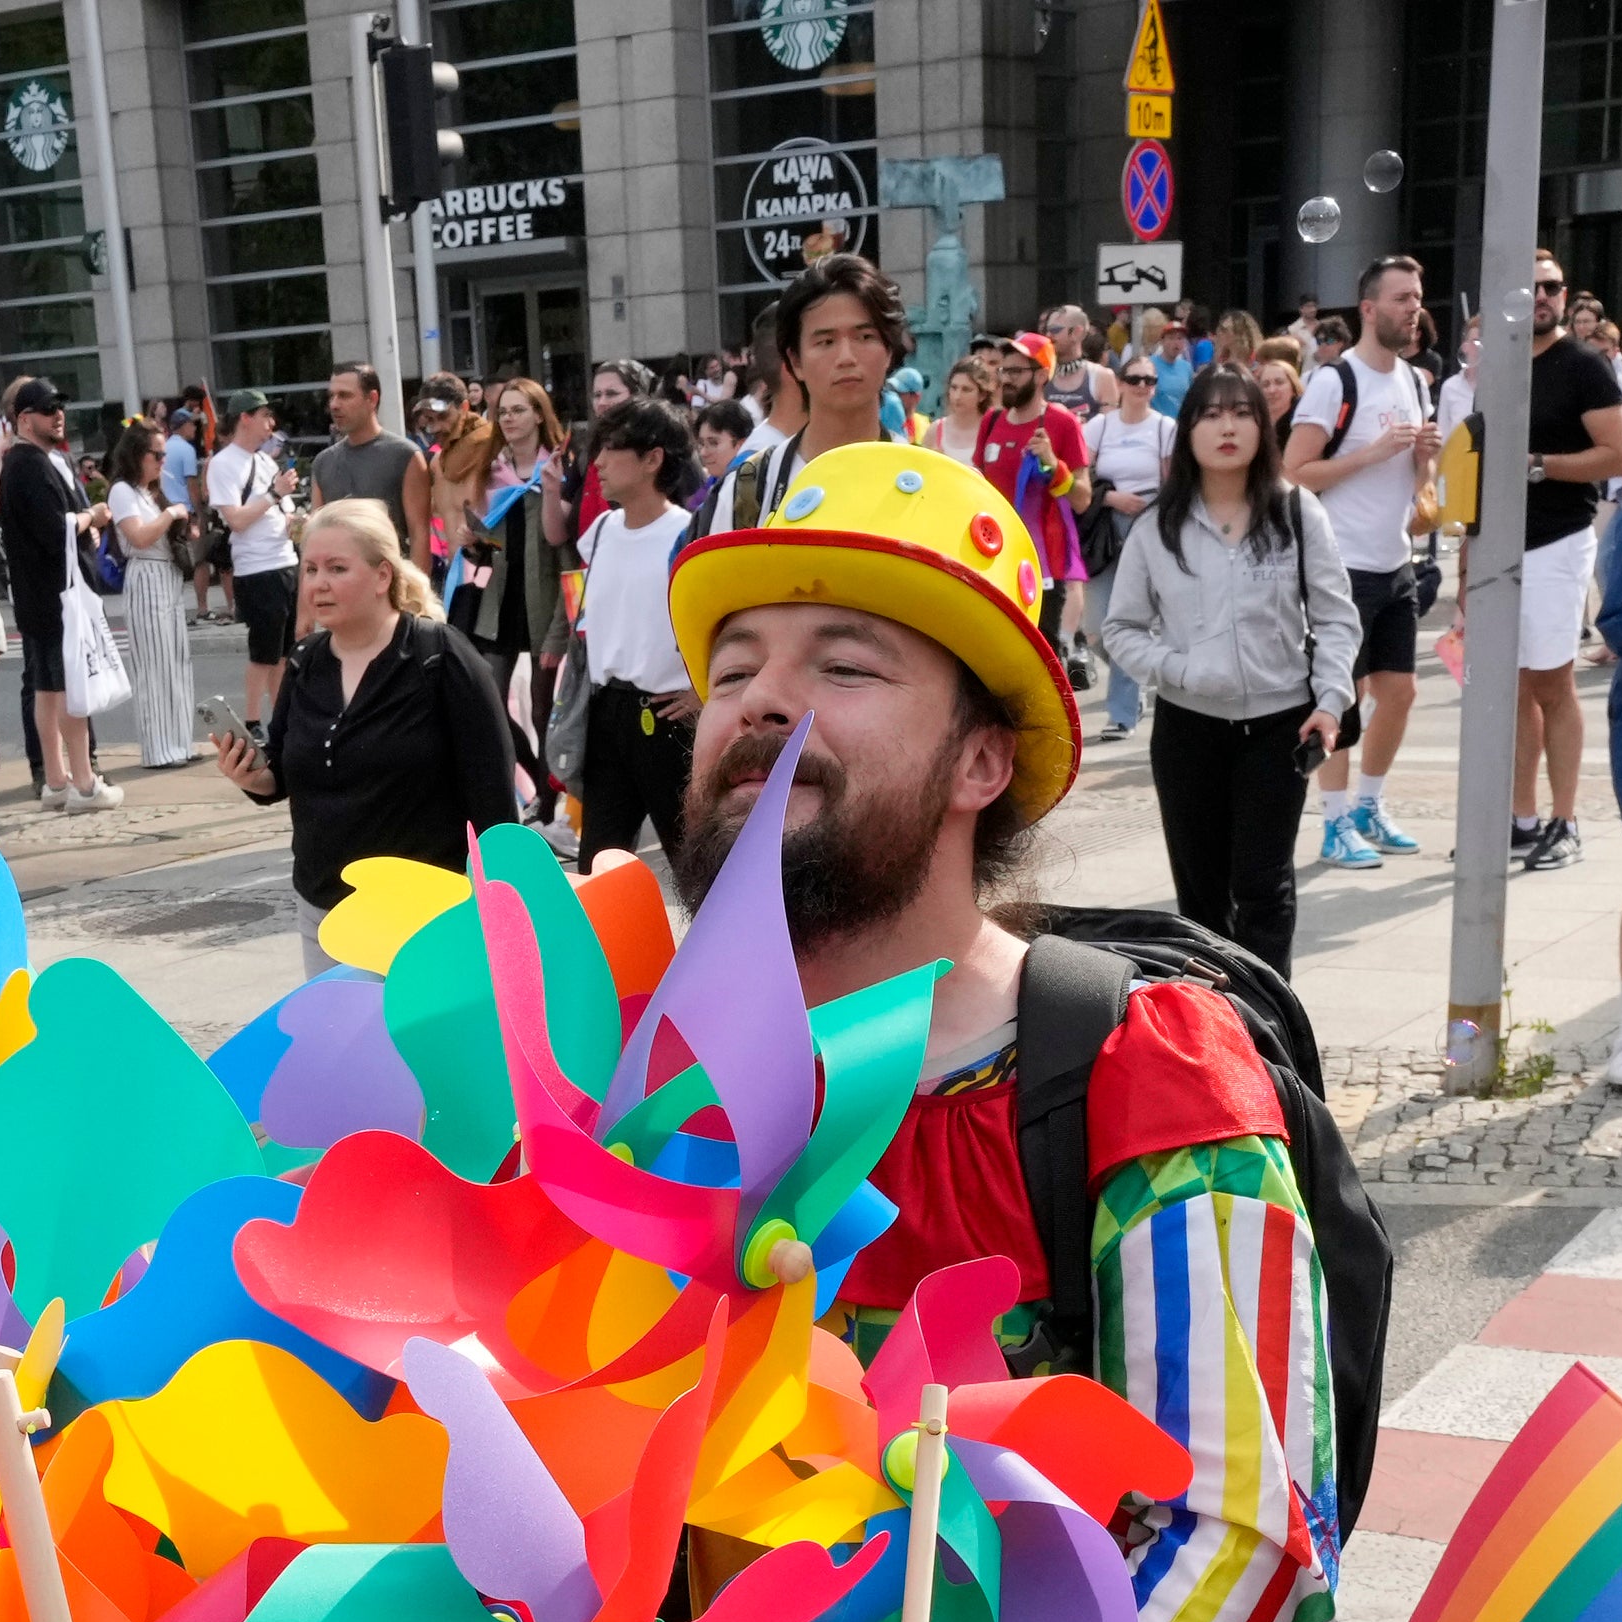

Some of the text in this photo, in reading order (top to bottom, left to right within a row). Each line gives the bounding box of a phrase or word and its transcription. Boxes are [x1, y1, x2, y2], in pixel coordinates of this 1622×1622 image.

[1137, 102, 1165, 130] 10m
[773, 155, 834, 184] KAWA
[797, 175, 814, 194] &
[389, 177, 566, 223] ARBUCKS
[755, 192, 853, 218] KANAPKA
[430, 213, 533, 249] COFFEE
